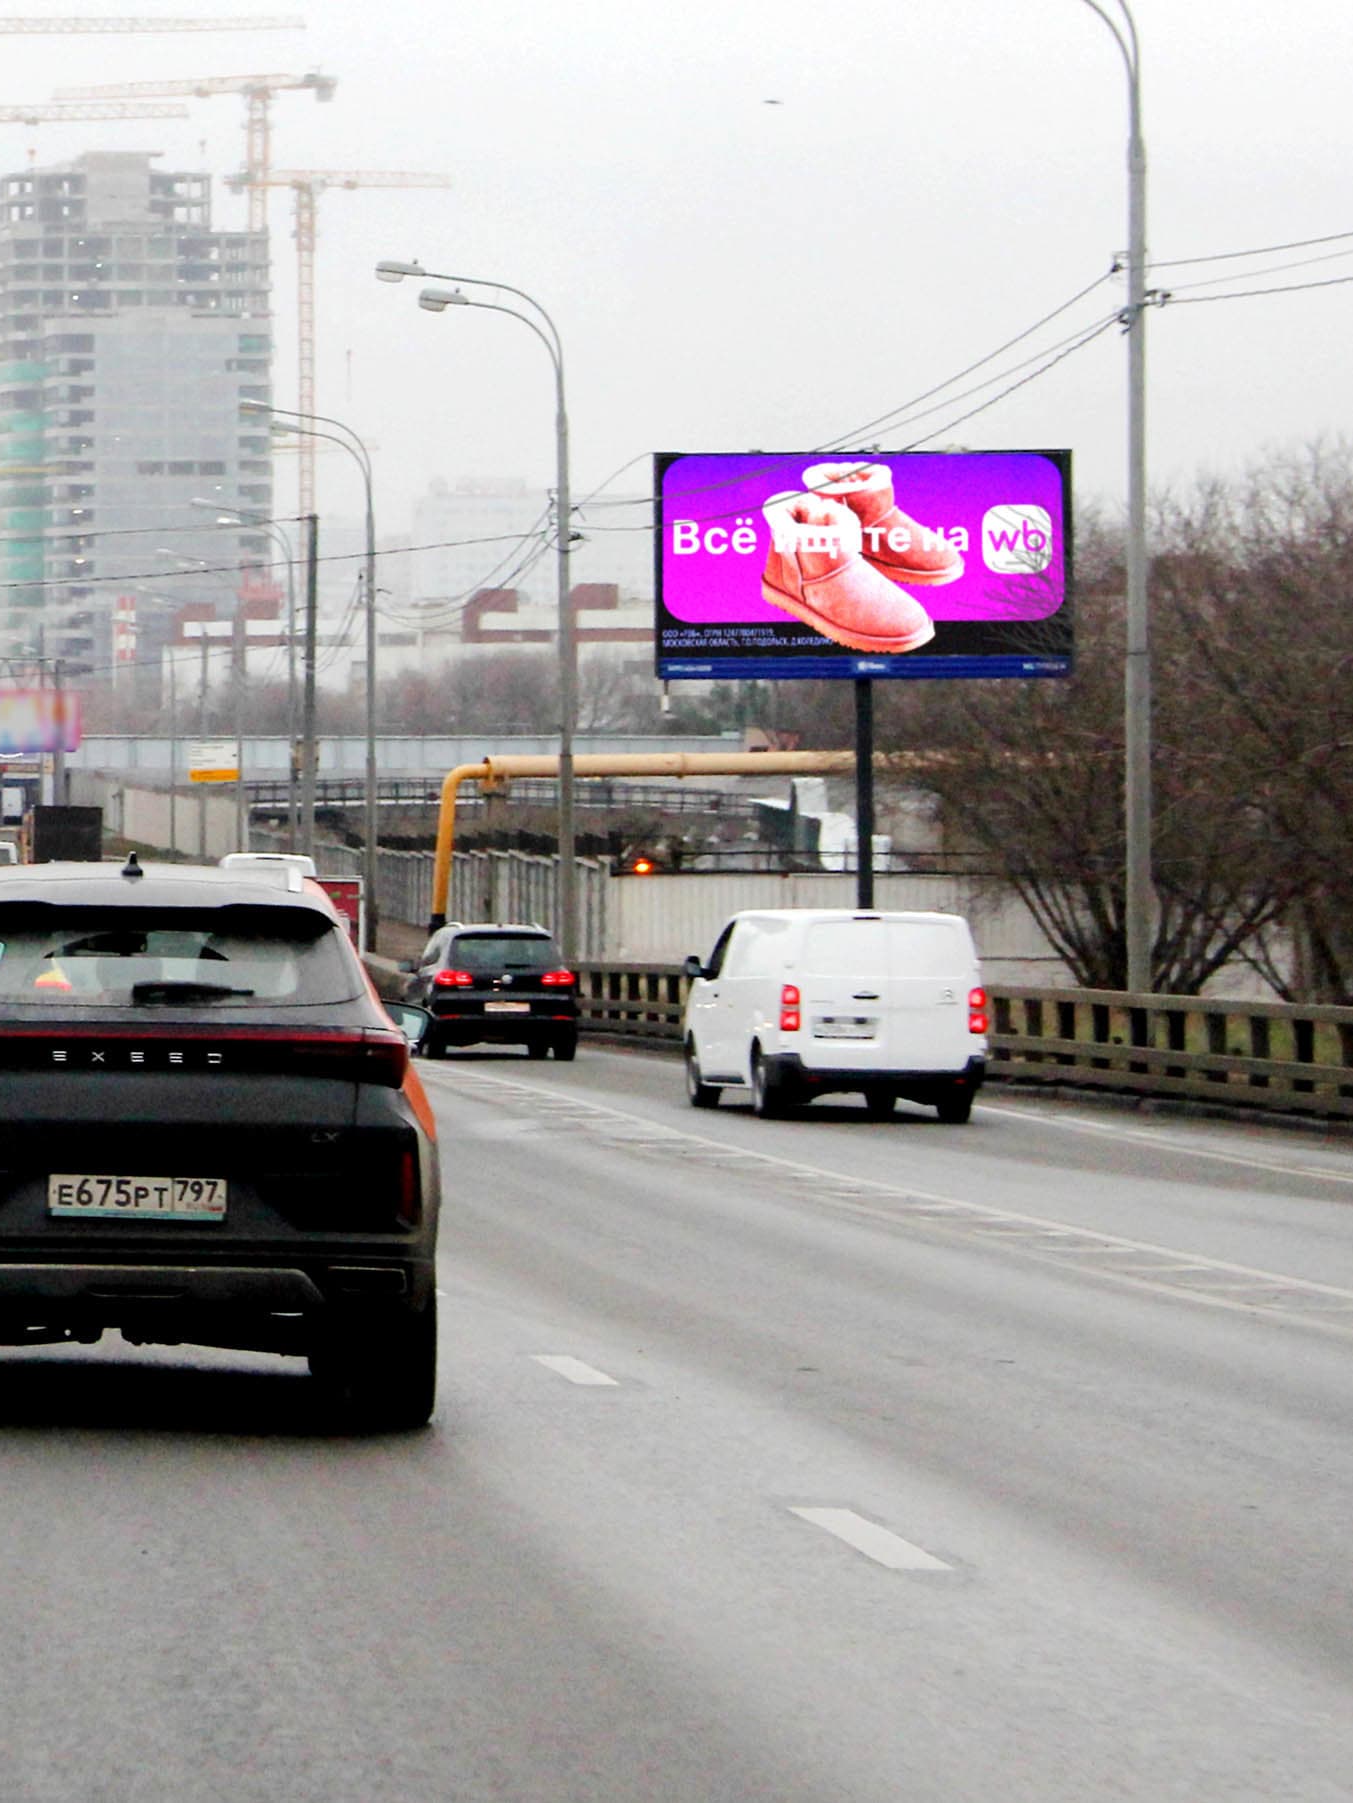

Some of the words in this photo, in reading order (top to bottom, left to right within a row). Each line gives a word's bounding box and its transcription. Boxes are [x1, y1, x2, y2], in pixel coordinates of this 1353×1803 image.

[671, 517, 758, 555] Всё
[922, 526, 969, 553] на
[51, 1050, 223, 1064] EXEED
